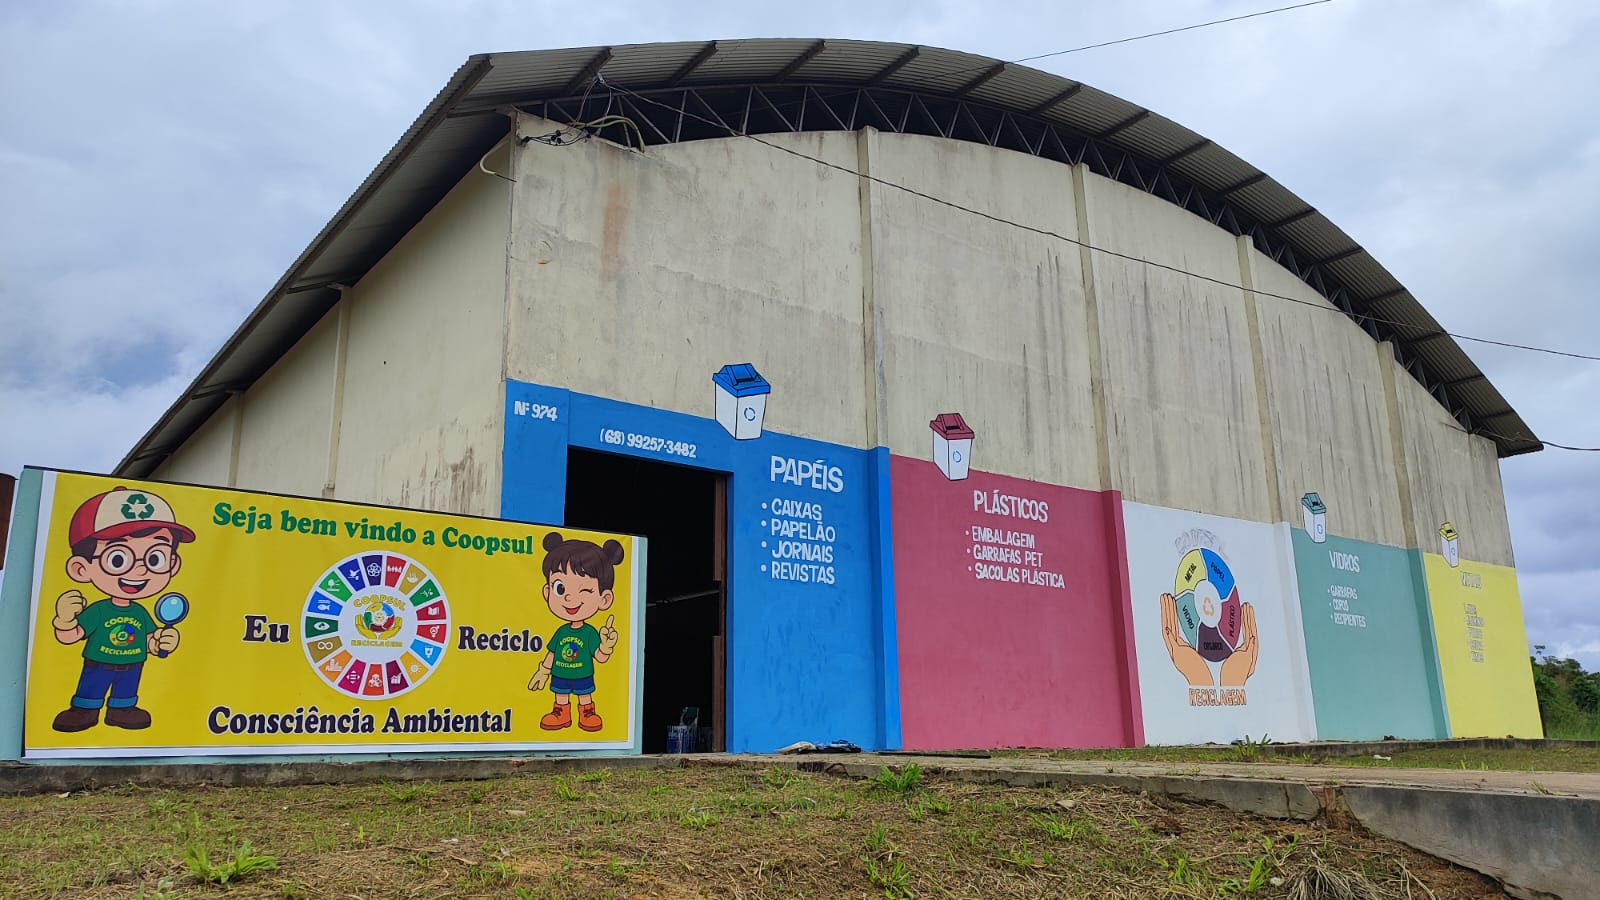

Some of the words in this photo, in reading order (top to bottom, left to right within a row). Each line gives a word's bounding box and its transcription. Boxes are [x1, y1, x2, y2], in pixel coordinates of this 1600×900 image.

[531, 403, 558, 422] 974
[600, 428, 625, 446] (68)
[770, 455, 844, 493] PAPÉIS
[771, 498, 822, 521] CAIXAS
[973, 489, 1049, 523] PLÁSTICOS
[212, 502, 272, 534] Seja
[281, 510, 336, 536] bem
[345, 518, 416, 544] vindo
[423, 532, 435, 545] a
[442, 527, 533, 555] Coopsul
[771, 518, 836, 543] PAPELÃO
[972, 526, 1035, 549] EMBALAGEM
[771, 540, 834, 564] JORNAIS
[973, 544, 1021, 564] GARRAFAS
[1025, 551, 1043, 567] PET
[1329, 550, 1360, 573] VIDROS
[771, 562, 835, 585] REVISTAS
[975, 563, 1020, 583] SACOLAS
[1021, 568, 1065, 588] PLÁSTICA
[1185, 563, 1197, 583] METAL
[1210, 561, 1226, 583] PAPEL
[104, 617, 142, 630] COOPSUL
[244, 615, 289, 642] Eu
[1182, 605, 1195, 630] VIDRO
[458, 626, 542, 652] Reciclo
[559, 637, 584, 648] COOPSUL
[1189, 688, 1247, 706] RECICLAGEM
[208, 706, 375, 735] Consciência
[381, 708, 512, 734] Ambiental
